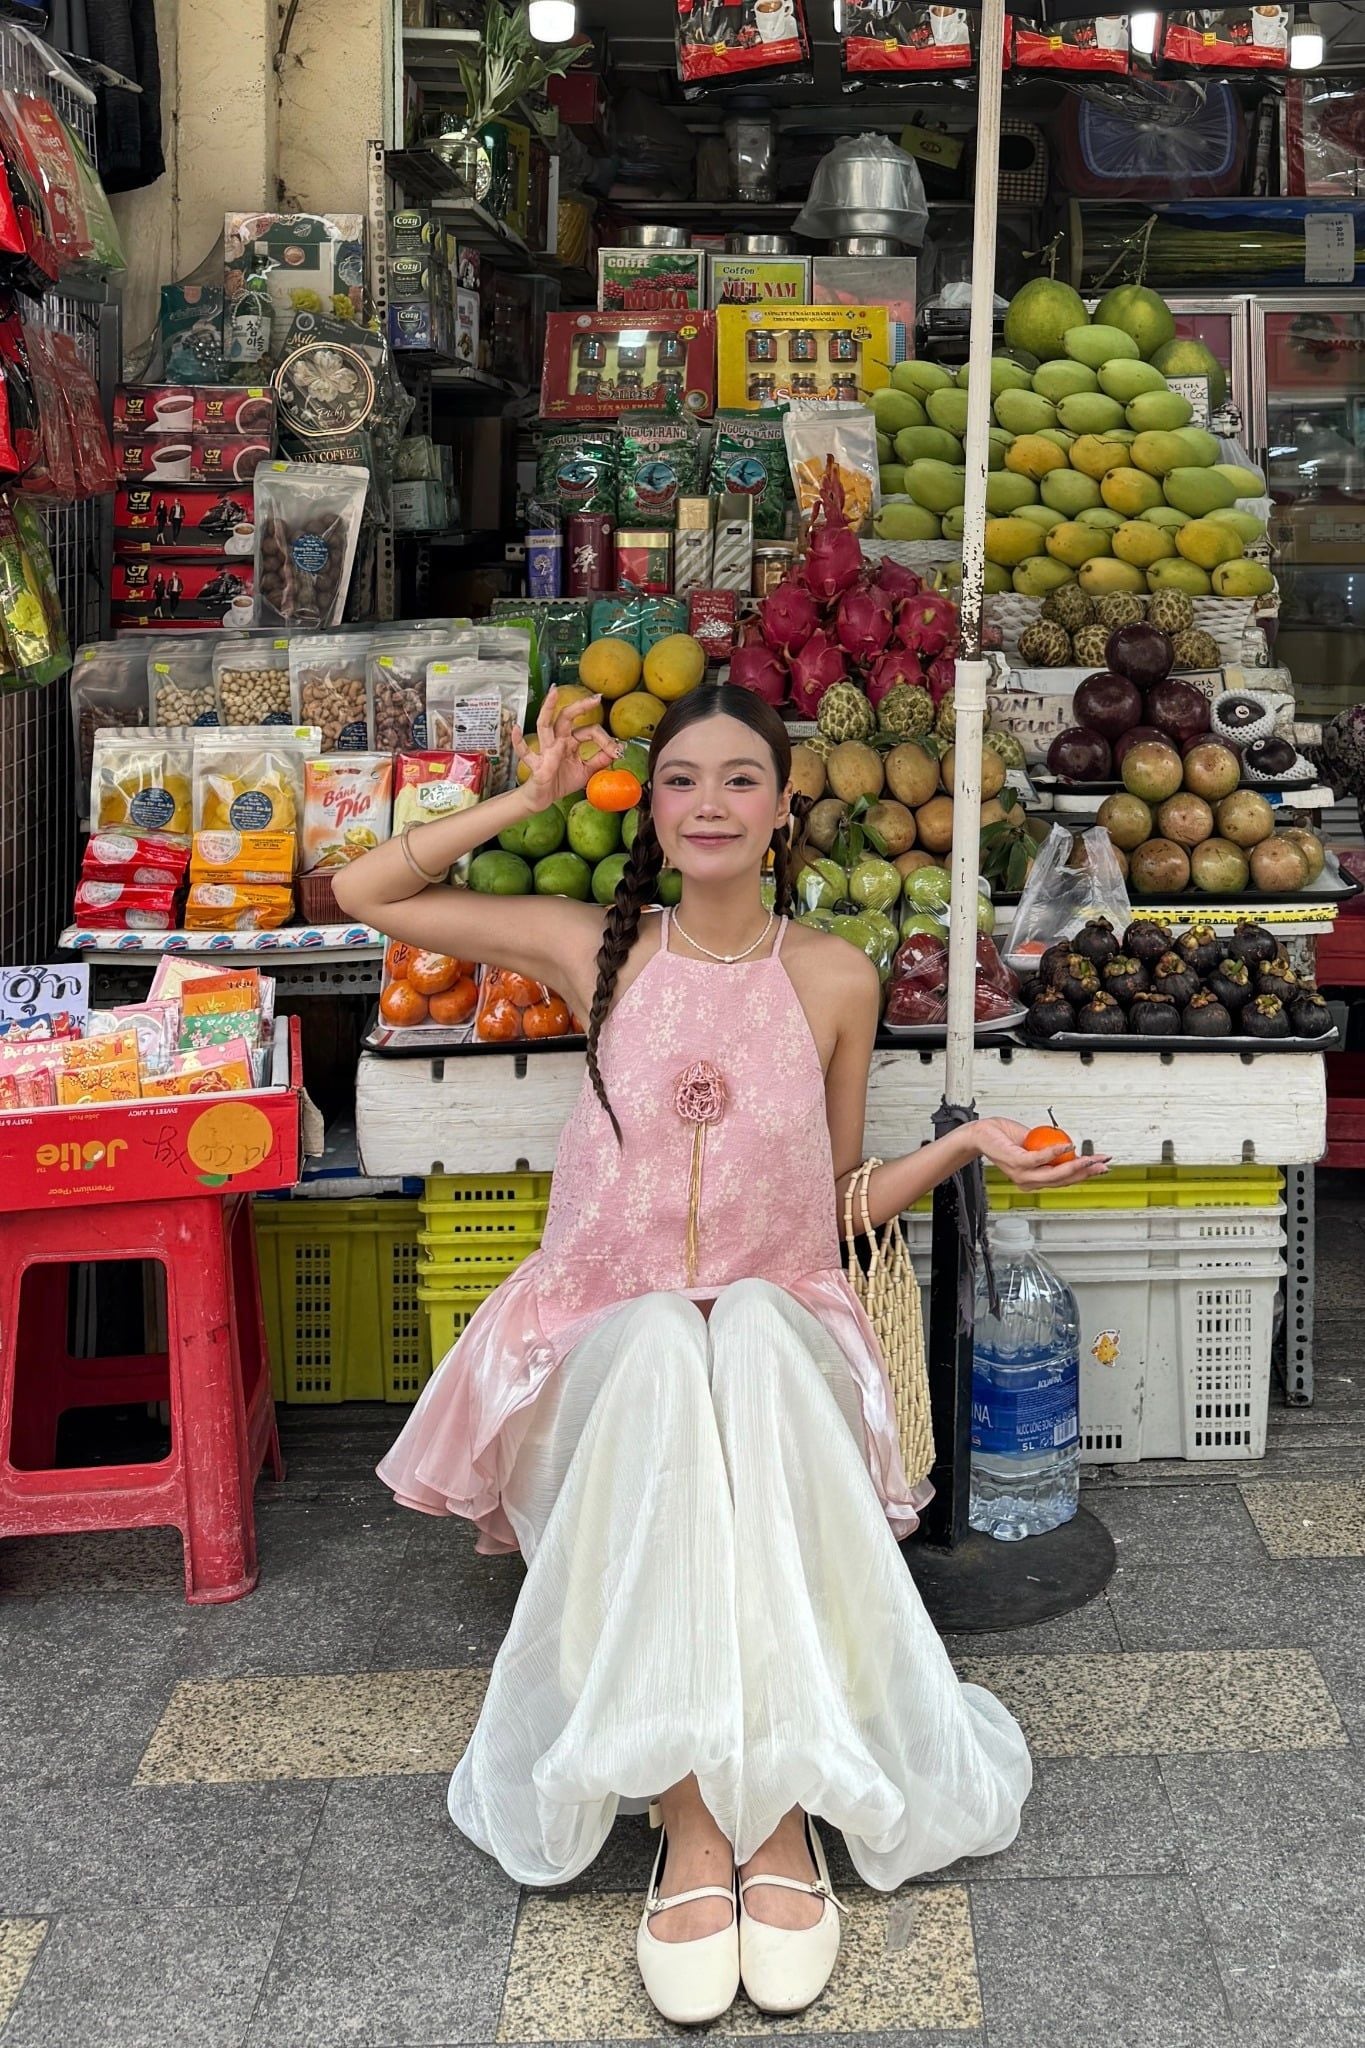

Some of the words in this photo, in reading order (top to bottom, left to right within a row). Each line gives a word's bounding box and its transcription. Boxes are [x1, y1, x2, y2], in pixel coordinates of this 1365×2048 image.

[396, 216, 418, 226] Cozy
[396, 262, 418, 272] Cozy
[607, 257, 650, 269] COFFEE
[764, 282, 798, 298] NAM
[623, 289, 689, 311] MOKA
[400, 311, 419, 320] Cozy
[127, 399, 144, 408] G7
[206, 401, 223, 409] G7
[319, 447, 361, 462] COFFEE
[130, 491, 151, 503] G7
[127, 565, 149, 577] G7
[323, 783, 357, 808] Bánh
[335, 791, 371, 828] Pía
[128, 1109, 149, 1117] JUICY
[155, 1107, 178, 1116] SWEET
[12, 1118, 33, 1126] TASTY
[36, 1138, 129, 1172] Jolie
[48, 1186, 72, 1195] Pear
[72, 1185, 116, 1193] Premium
